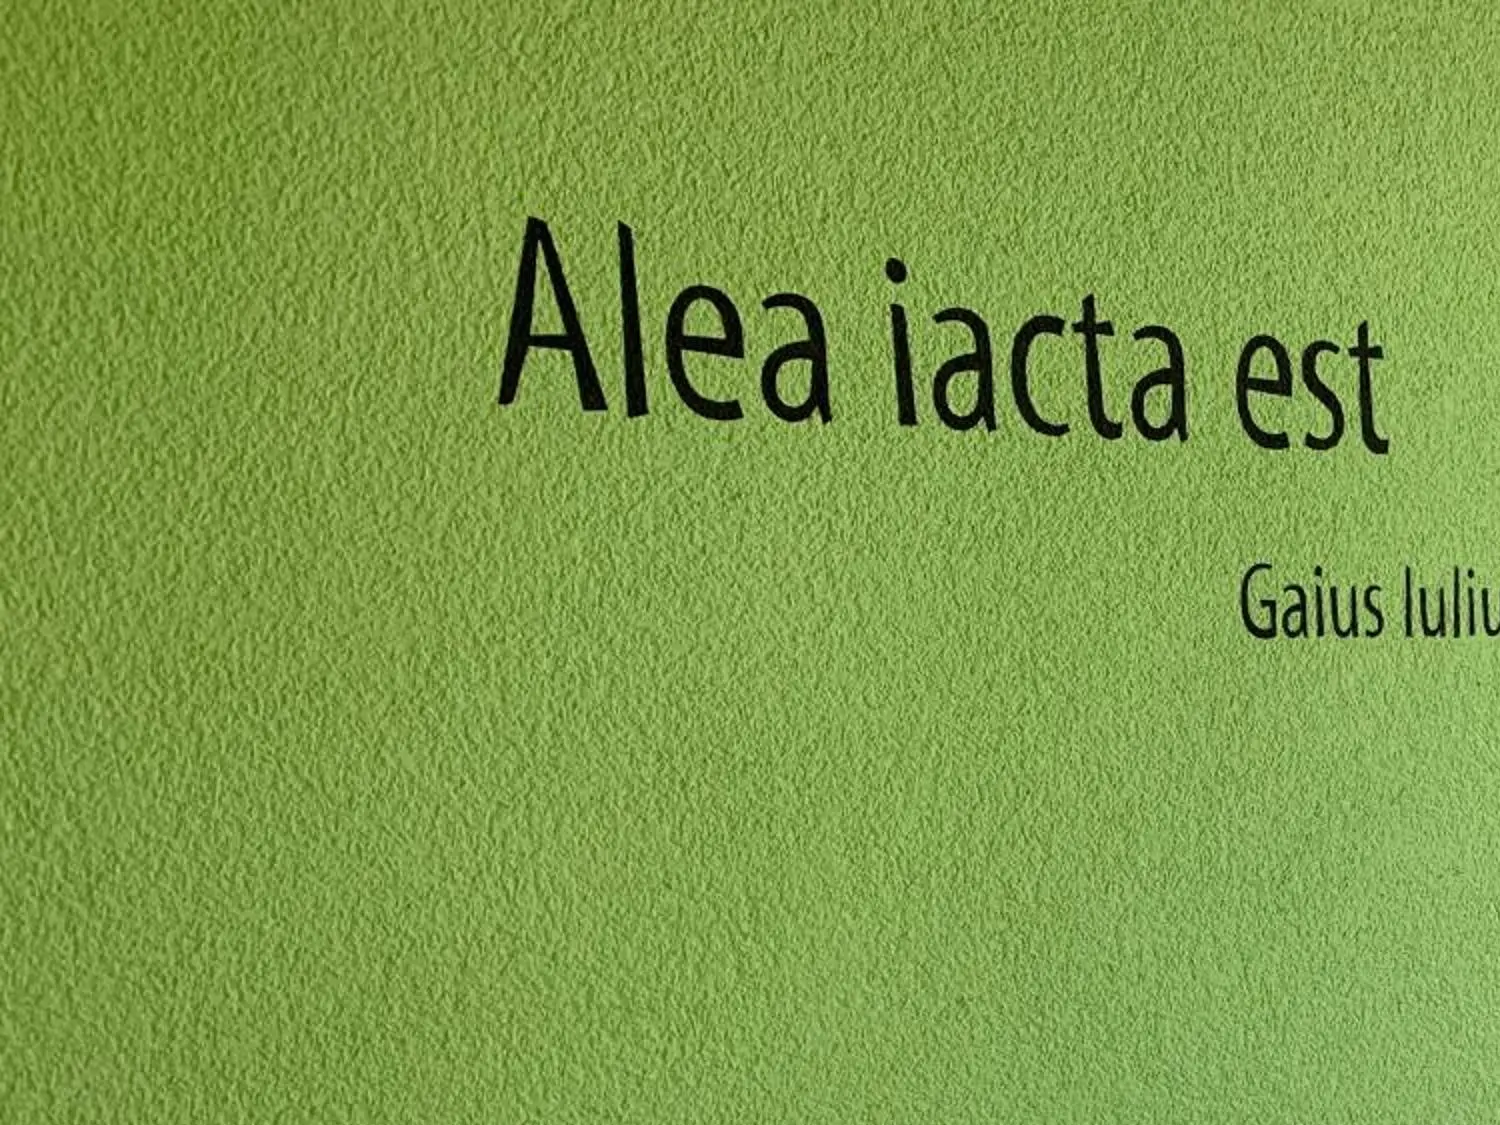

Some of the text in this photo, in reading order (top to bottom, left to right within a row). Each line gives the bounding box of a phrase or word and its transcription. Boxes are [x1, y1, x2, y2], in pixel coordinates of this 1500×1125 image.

[496, 214, 1391, 456] Alea iacta est
[1240, 561, 1386, 641] Gaius
